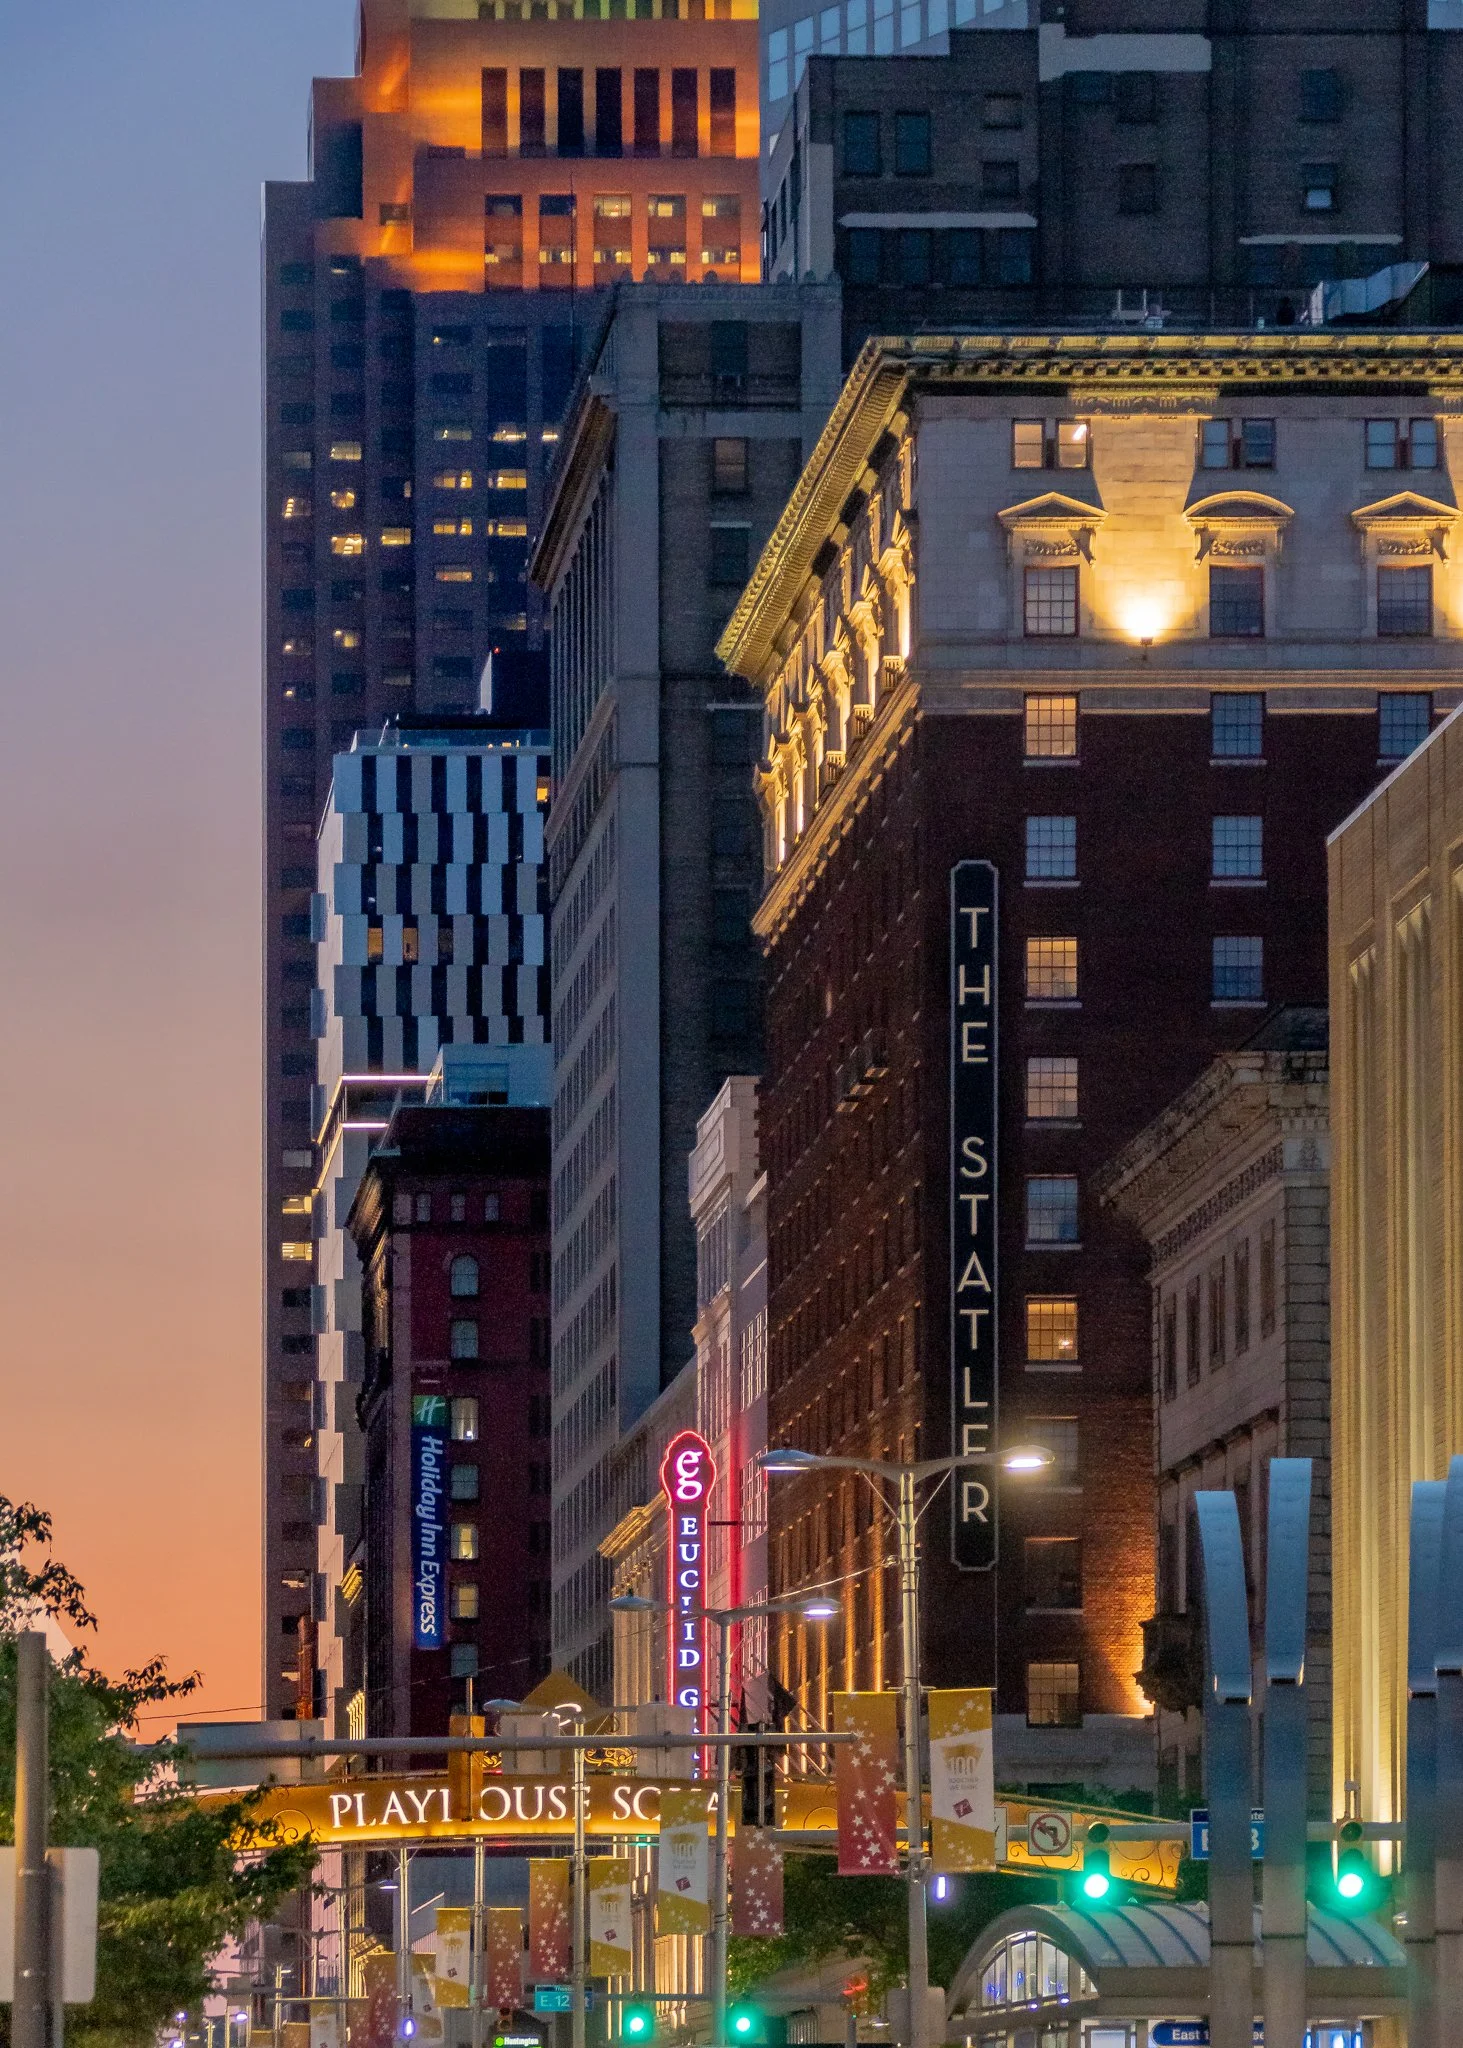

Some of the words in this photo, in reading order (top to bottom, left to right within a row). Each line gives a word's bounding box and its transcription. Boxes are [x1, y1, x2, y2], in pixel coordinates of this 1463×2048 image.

[958, 907, 991, 1064] THE
[957, 1136, 992, 1523] STATLER
[416, 1435, 443, 1520] Holiday
[421, 1522, 443, 1557] Inn
[416, 1560, 440, 1635] Express
[540, 1995, 552, 2007] E.
[1172, 2029, 1199, 2041] East
